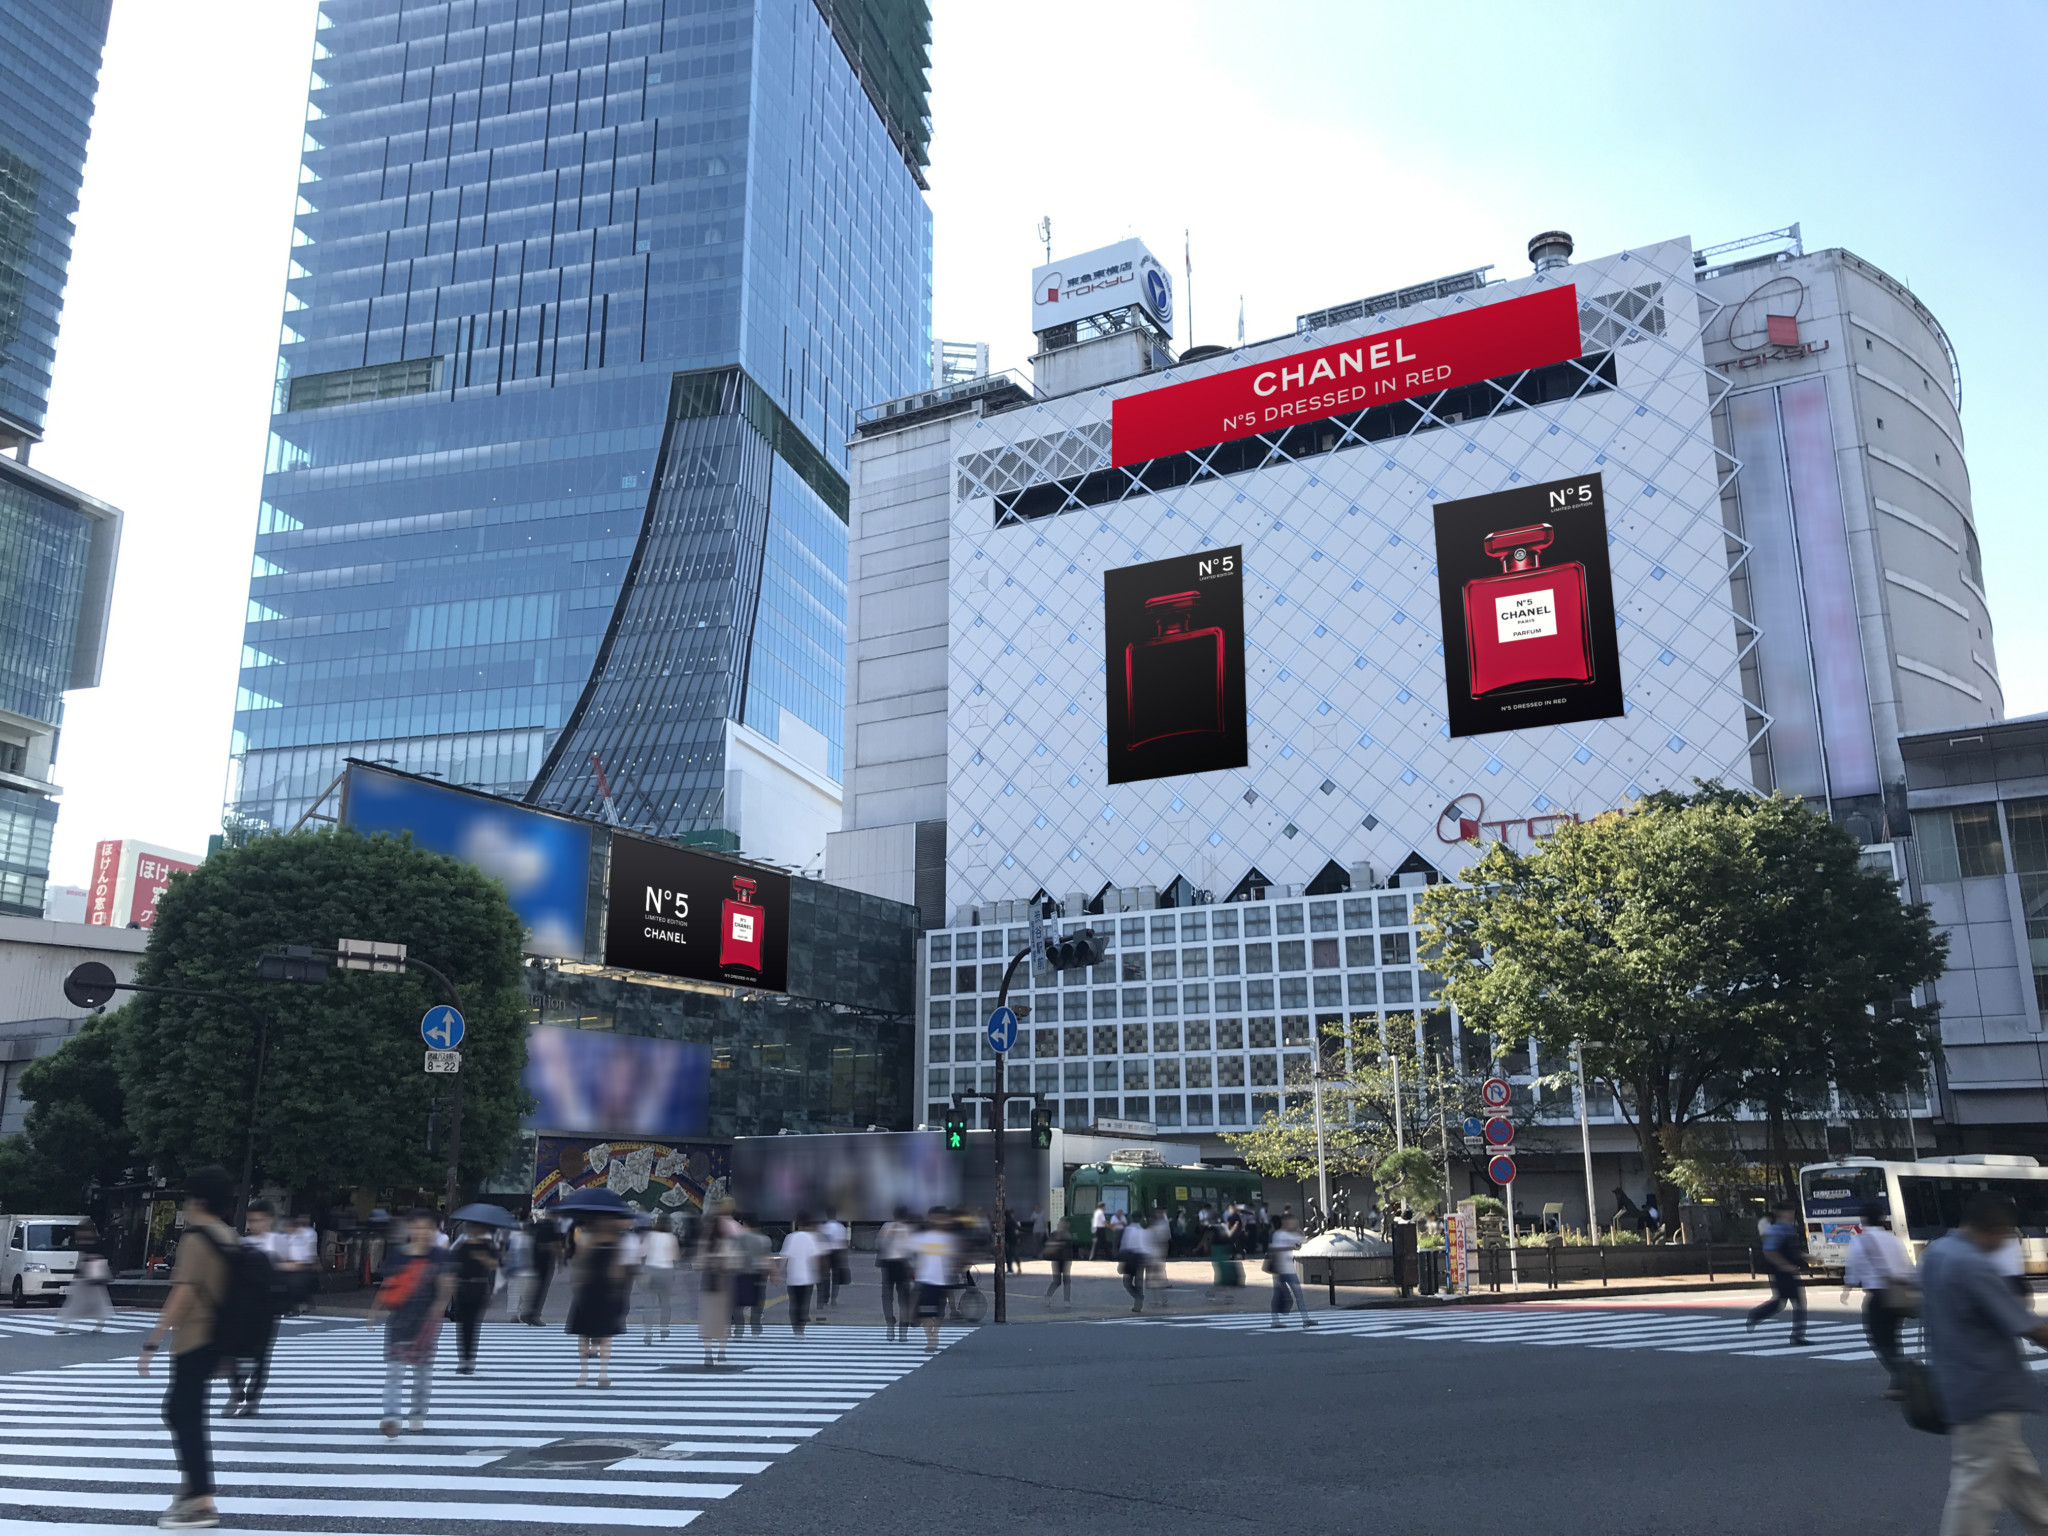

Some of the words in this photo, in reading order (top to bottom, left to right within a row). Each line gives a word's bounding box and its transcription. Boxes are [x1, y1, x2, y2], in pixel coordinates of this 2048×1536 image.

[1061, 272, 1135, 299] TOKYU
[1067, 261, 1133, 288] 東急東横店
[1253, 338, 1416, 396] CHANEL
[1715, 339, 1829, 373] TOKYU
[1265, 386, 1366, 422] DRESSED
[1375, 377, 1397, 396] IN
[1405, 364, 1452, 388] RED
[1550, 504, 1572, 513] LIMITED
[1572, 501, 1593, 510] EDITION
[1500, 605, 1551, 620] CHANEL
[1512, 628, 1542, 638] PARFUM
[1513, 701, 1543, 710] DRESSED
[1553, 697, 1567, 705] RED
[92, 843, 113, 925] ほけんの窓口
[644, 926, 687, 944] CHANEL
[529, 994, 567, 1010] tation
[1812, 1208, 1828, 1216] KEIO
[1828, 1207, 1842, 1215] BUS
[1456, 1220, 1466, 1282] バス停につき
